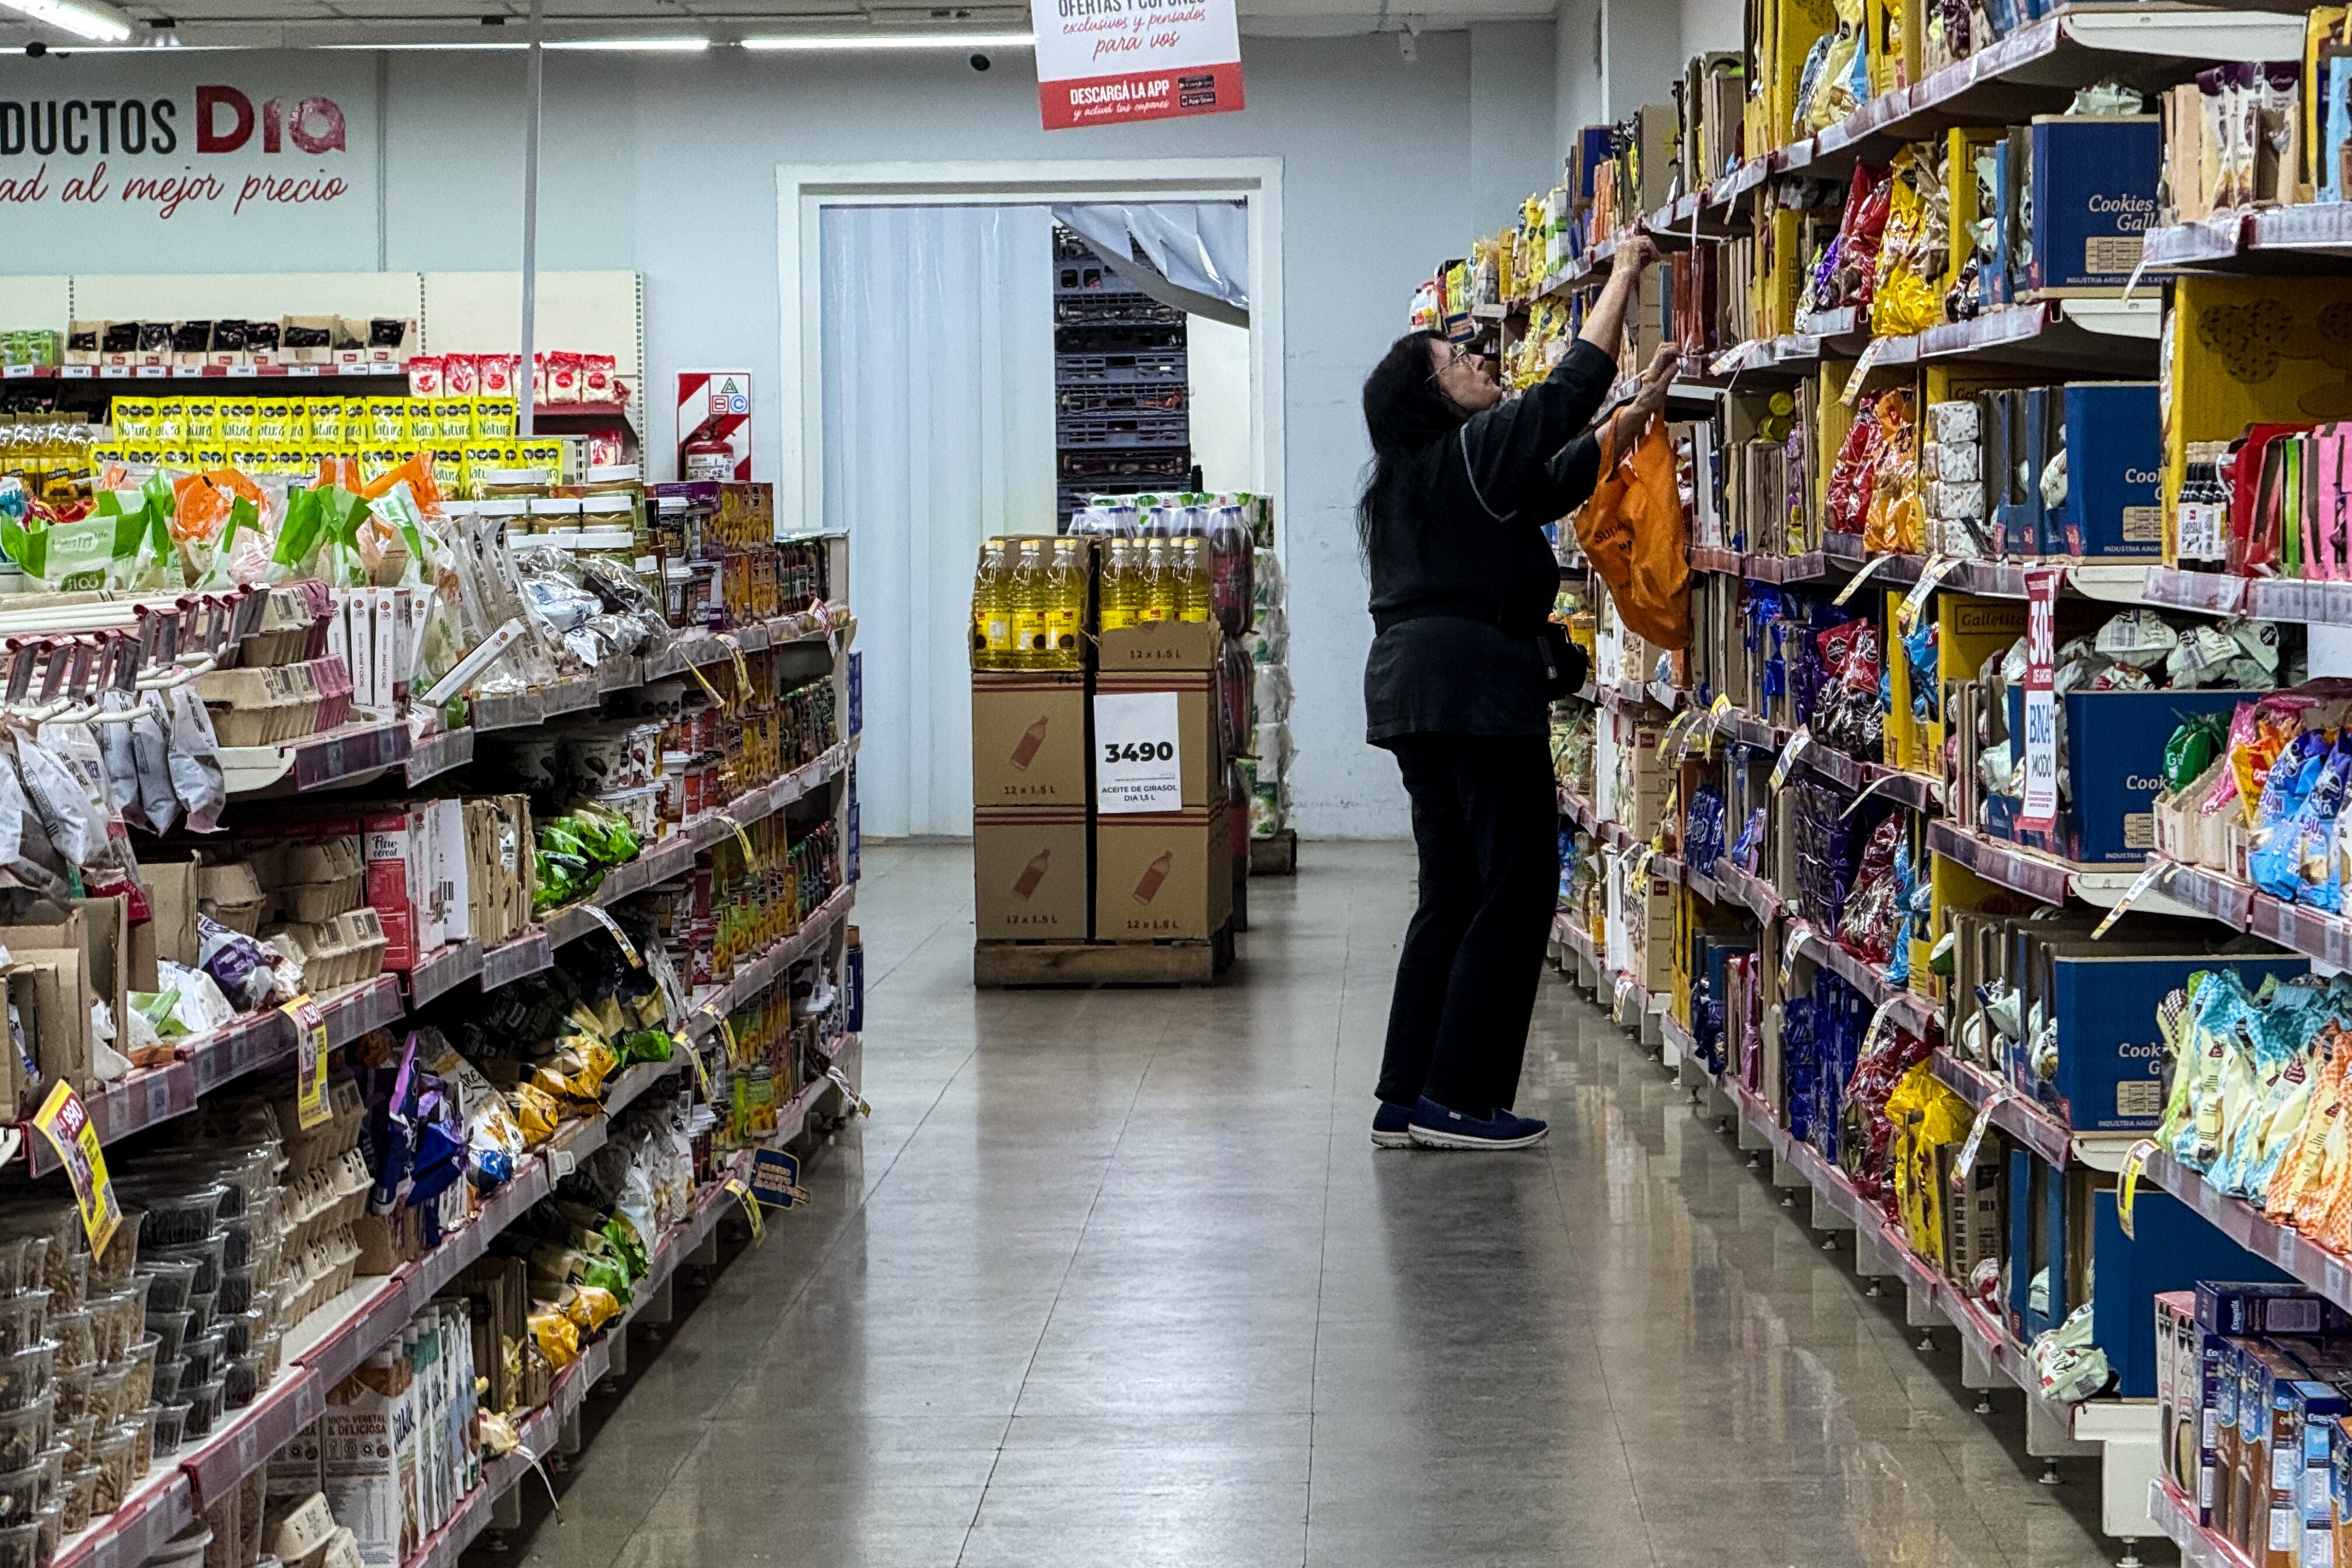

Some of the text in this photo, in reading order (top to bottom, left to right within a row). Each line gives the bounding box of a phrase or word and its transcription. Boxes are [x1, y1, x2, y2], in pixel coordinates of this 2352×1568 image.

[1062, 6, 1206, 34] exclusivos y pensados
[1092, 30, 1180, 62] para vos
[1069, 80, 1130, 106] DESCARGÁ
[1130, 82, 1148, 100] LA
[1147, 79, 1170, 97] APP
[1116, 102, 1132, 114] tus
[0, 101, 177, 155] DUCTOS
[61, 162, 110, 203] al
[122, 166, 225, 220] mejor
[233, 169, 349, 215] precio
[2088, 192, 2154, 212] Cookies
[478, 421, 511, 436] Natura
[1130, 650, 1142, 658] 12
[1104, 741, 1174, 764] 3490
[1101, 786, 1129, 794] ACEITE
[1143, 784, 1178, 792] GIRASOL
[372, 834, 399, 850] Flow
[373, 848, 398, 858] cereal
[1006, 915, 1020, 923] 12
[1127, 920, 1139, 929] 12
[352, 1414, 385, 1423] VEGETAL
[327, 1426, 335, 1436] &
[338, 1424, 387, 1435] DELICIOSA
